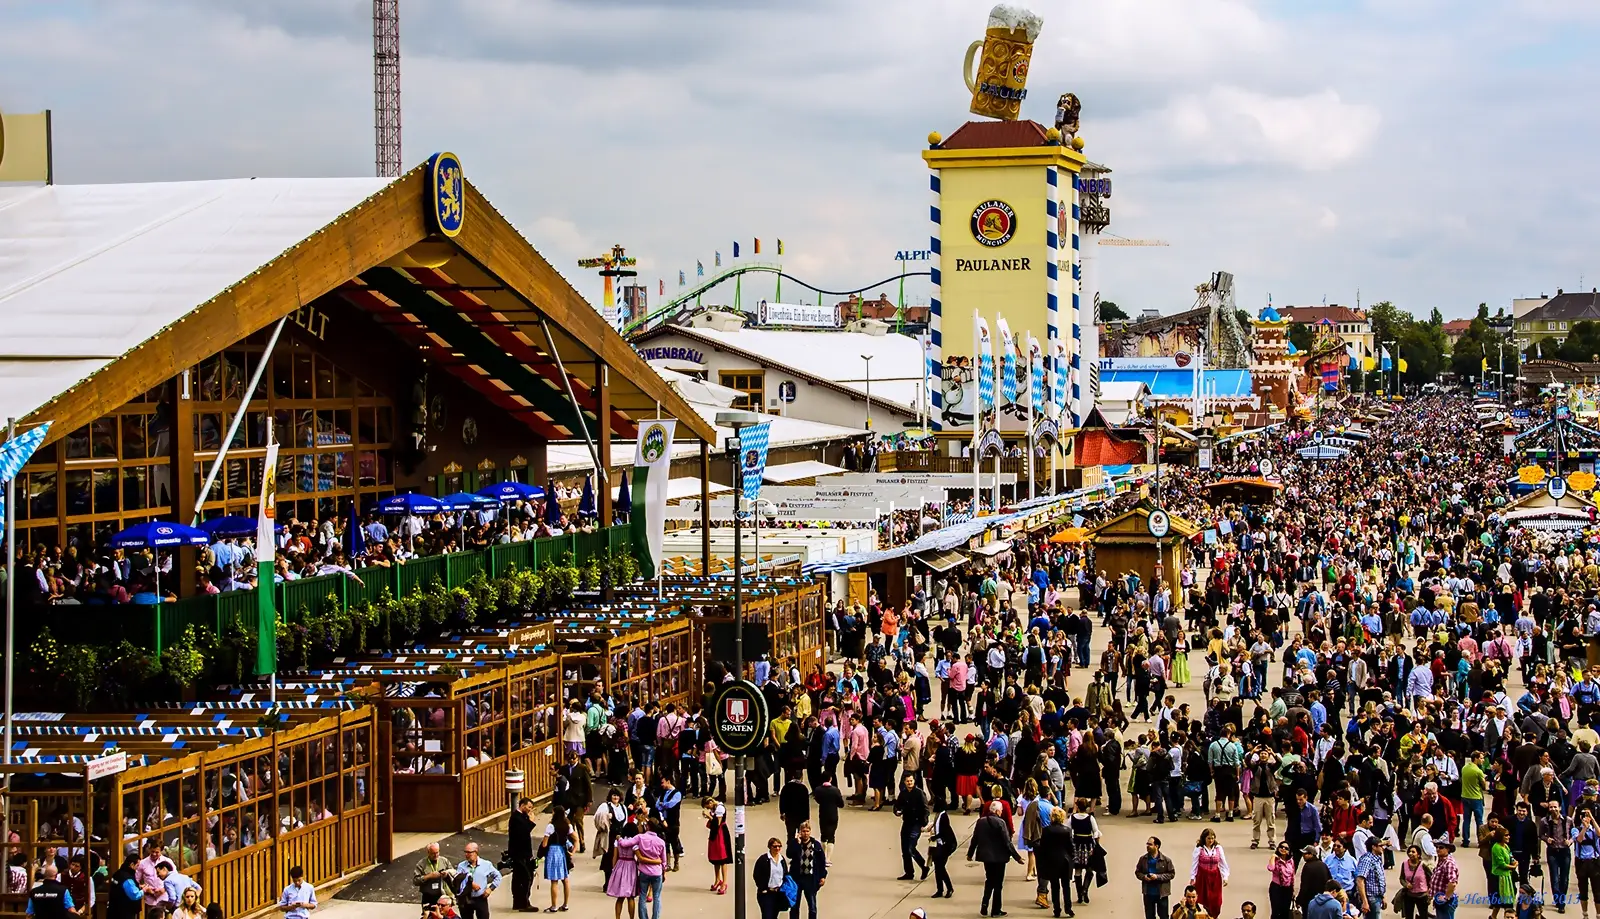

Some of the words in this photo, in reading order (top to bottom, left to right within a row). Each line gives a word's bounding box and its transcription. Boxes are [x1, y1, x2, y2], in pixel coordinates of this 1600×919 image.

[973, 201, 1014, 218] PAULANER
[956, 258, 1031, 272] PAULANER
[288, 306, 330, 341] ELT
[721, 724, 753, 732] SPATEN
